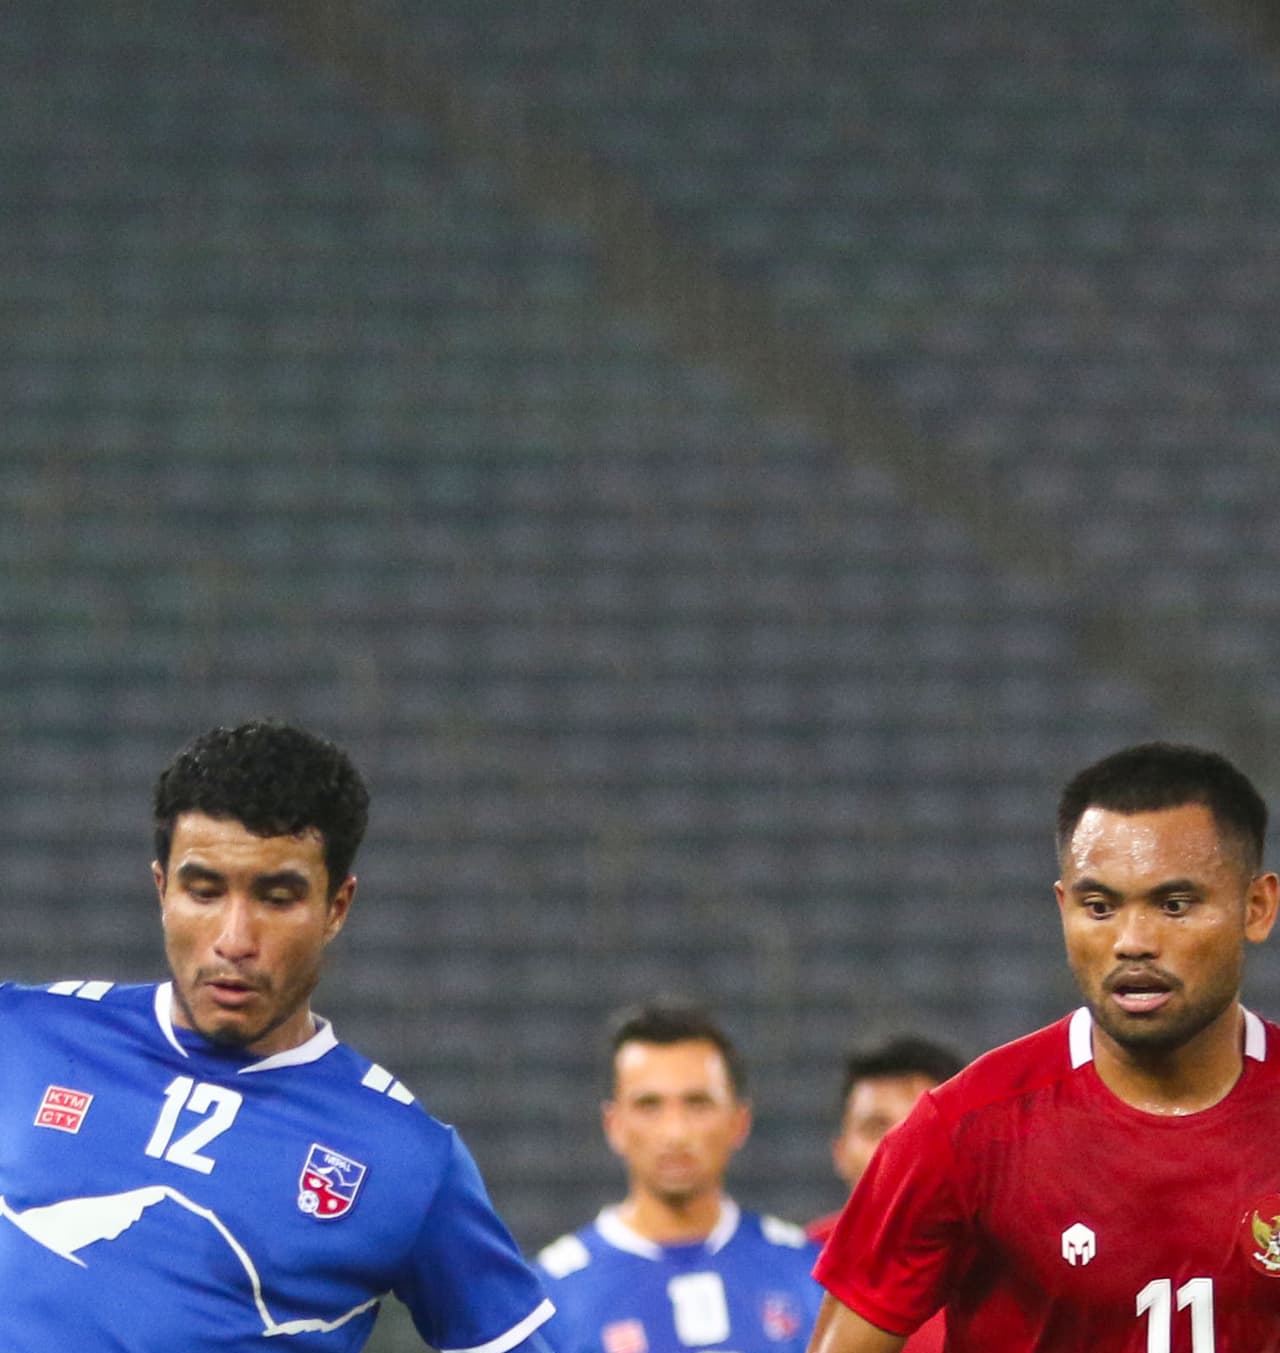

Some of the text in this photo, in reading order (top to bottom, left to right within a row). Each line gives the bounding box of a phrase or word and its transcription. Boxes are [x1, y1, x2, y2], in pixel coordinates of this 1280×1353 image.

[49, 1091, 85, 1109] KTM
[42, 1111, 77, 1126] CTY
[144, 1075, 243, 1175] 12
